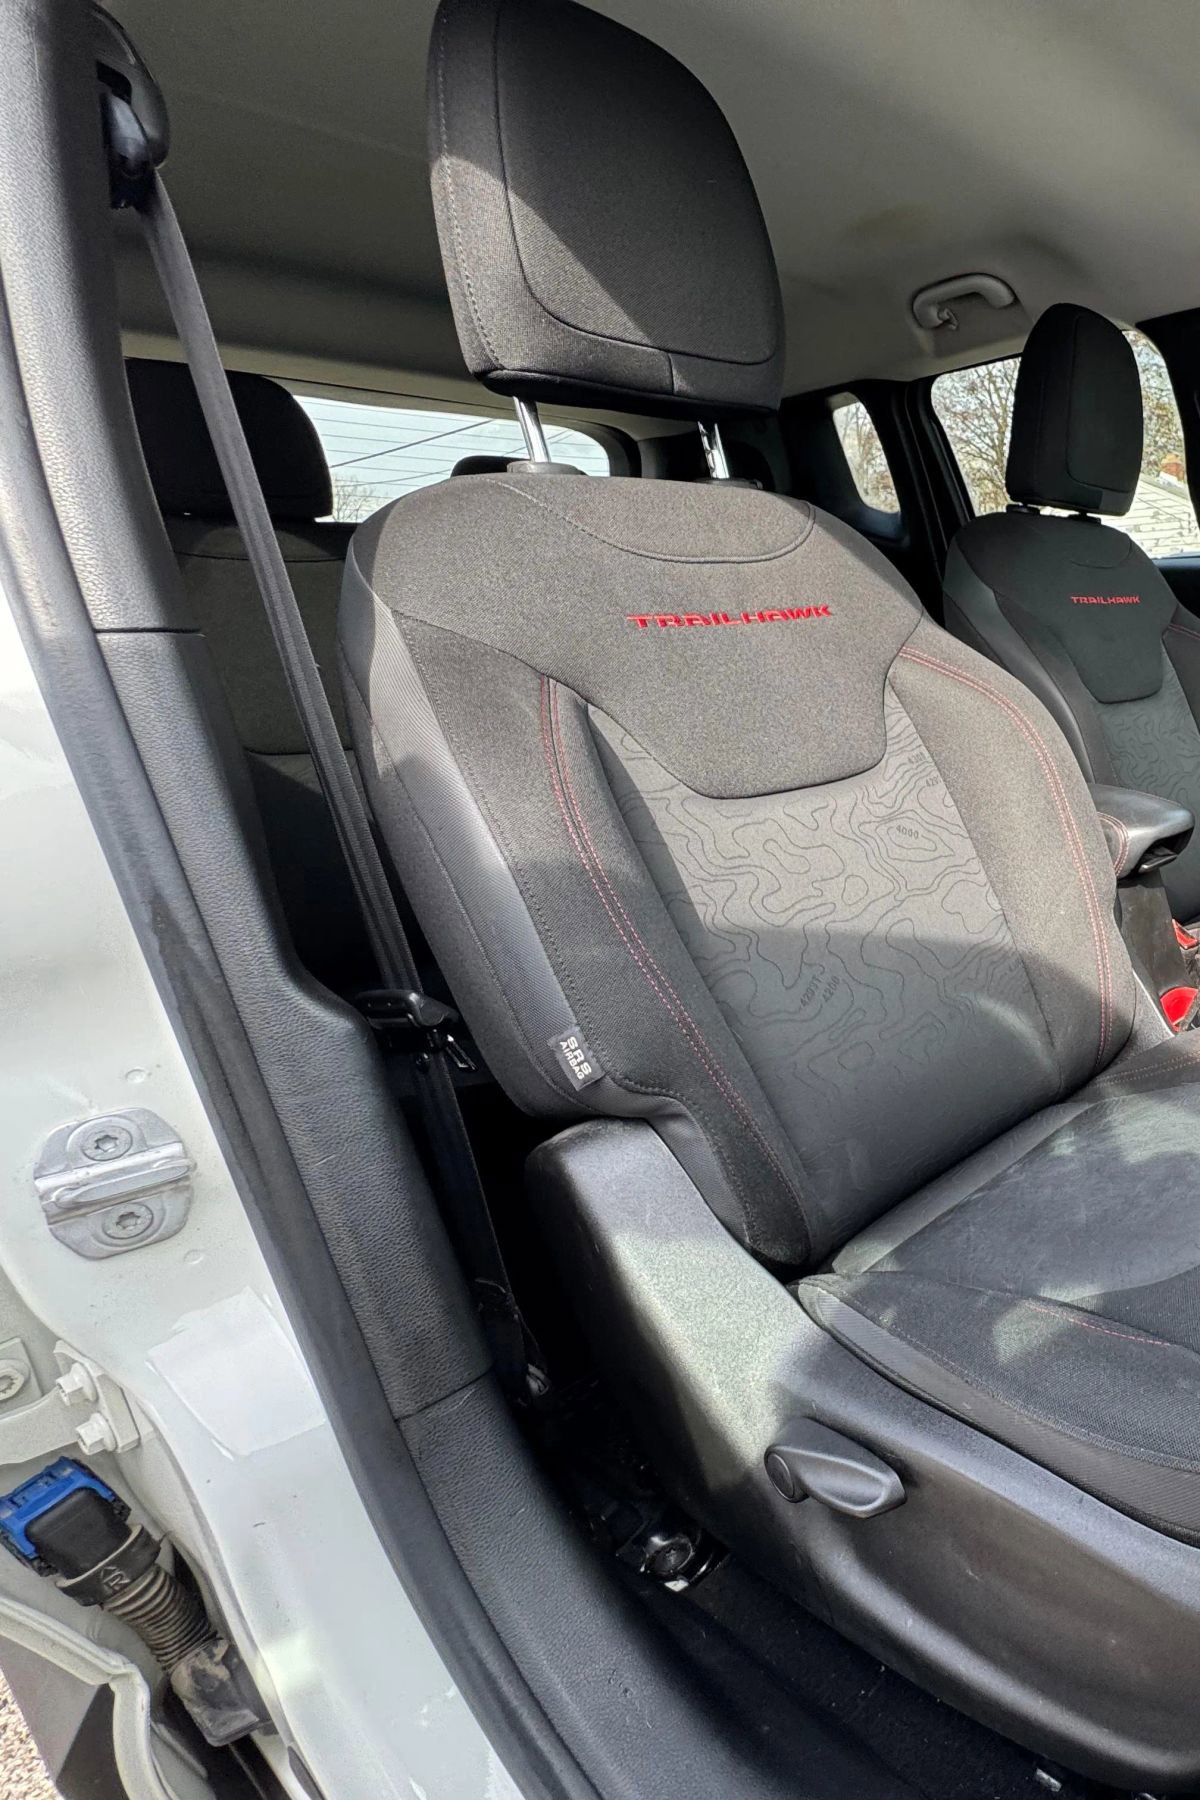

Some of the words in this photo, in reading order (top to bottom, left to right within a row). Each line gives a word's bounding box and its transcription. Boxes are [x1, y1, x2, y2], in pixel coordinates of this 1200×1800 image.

[1071, 595, 1141, 605] TRAILHAWK
[626, 603, 832, 629] TRAILHAWK
[896, 824, 919, 840] 4000
[559, 1041, 585, 1080] AIRBAG
[567, 1036, 592, 1075] SRS
